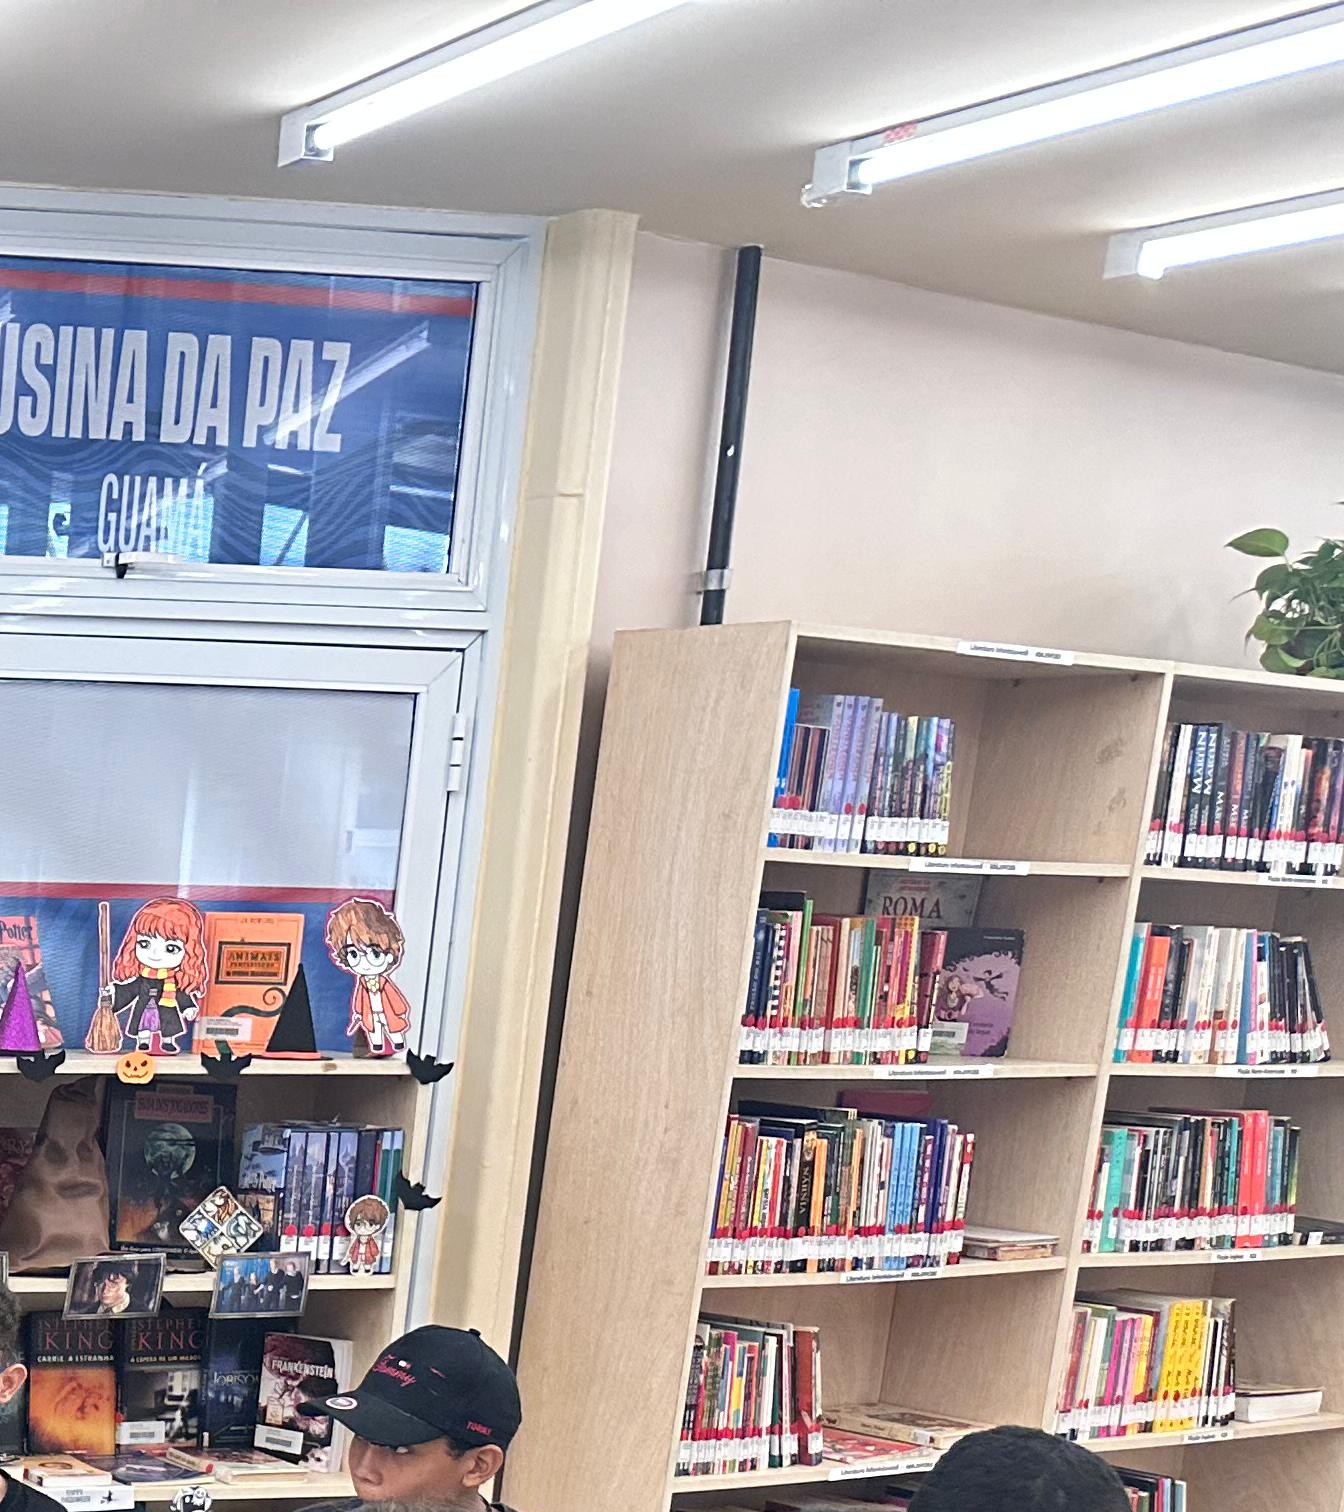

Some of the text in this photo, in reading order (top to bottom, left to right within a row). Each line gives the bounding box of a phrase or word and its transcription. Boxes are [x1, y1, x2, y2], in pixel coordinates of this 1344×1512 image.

[160, 331, 231, 447] DA
[242, 336, 352, 453] PAZ
[97, 463, 208, 556] GUAMÁ
[1192, 731, 1208, 795] MARTIN
[882, 896, 943, 920] ROMA
[45, 1330, 113, 1351] KING
[138, 1330, 202, 1351] KING
[37, 1355, 64, 1363] CARRIE
[75, 1355, 114, 1363] ESTRANHA
[271, 1359, 334, 1379] FRANKENSTEIN
